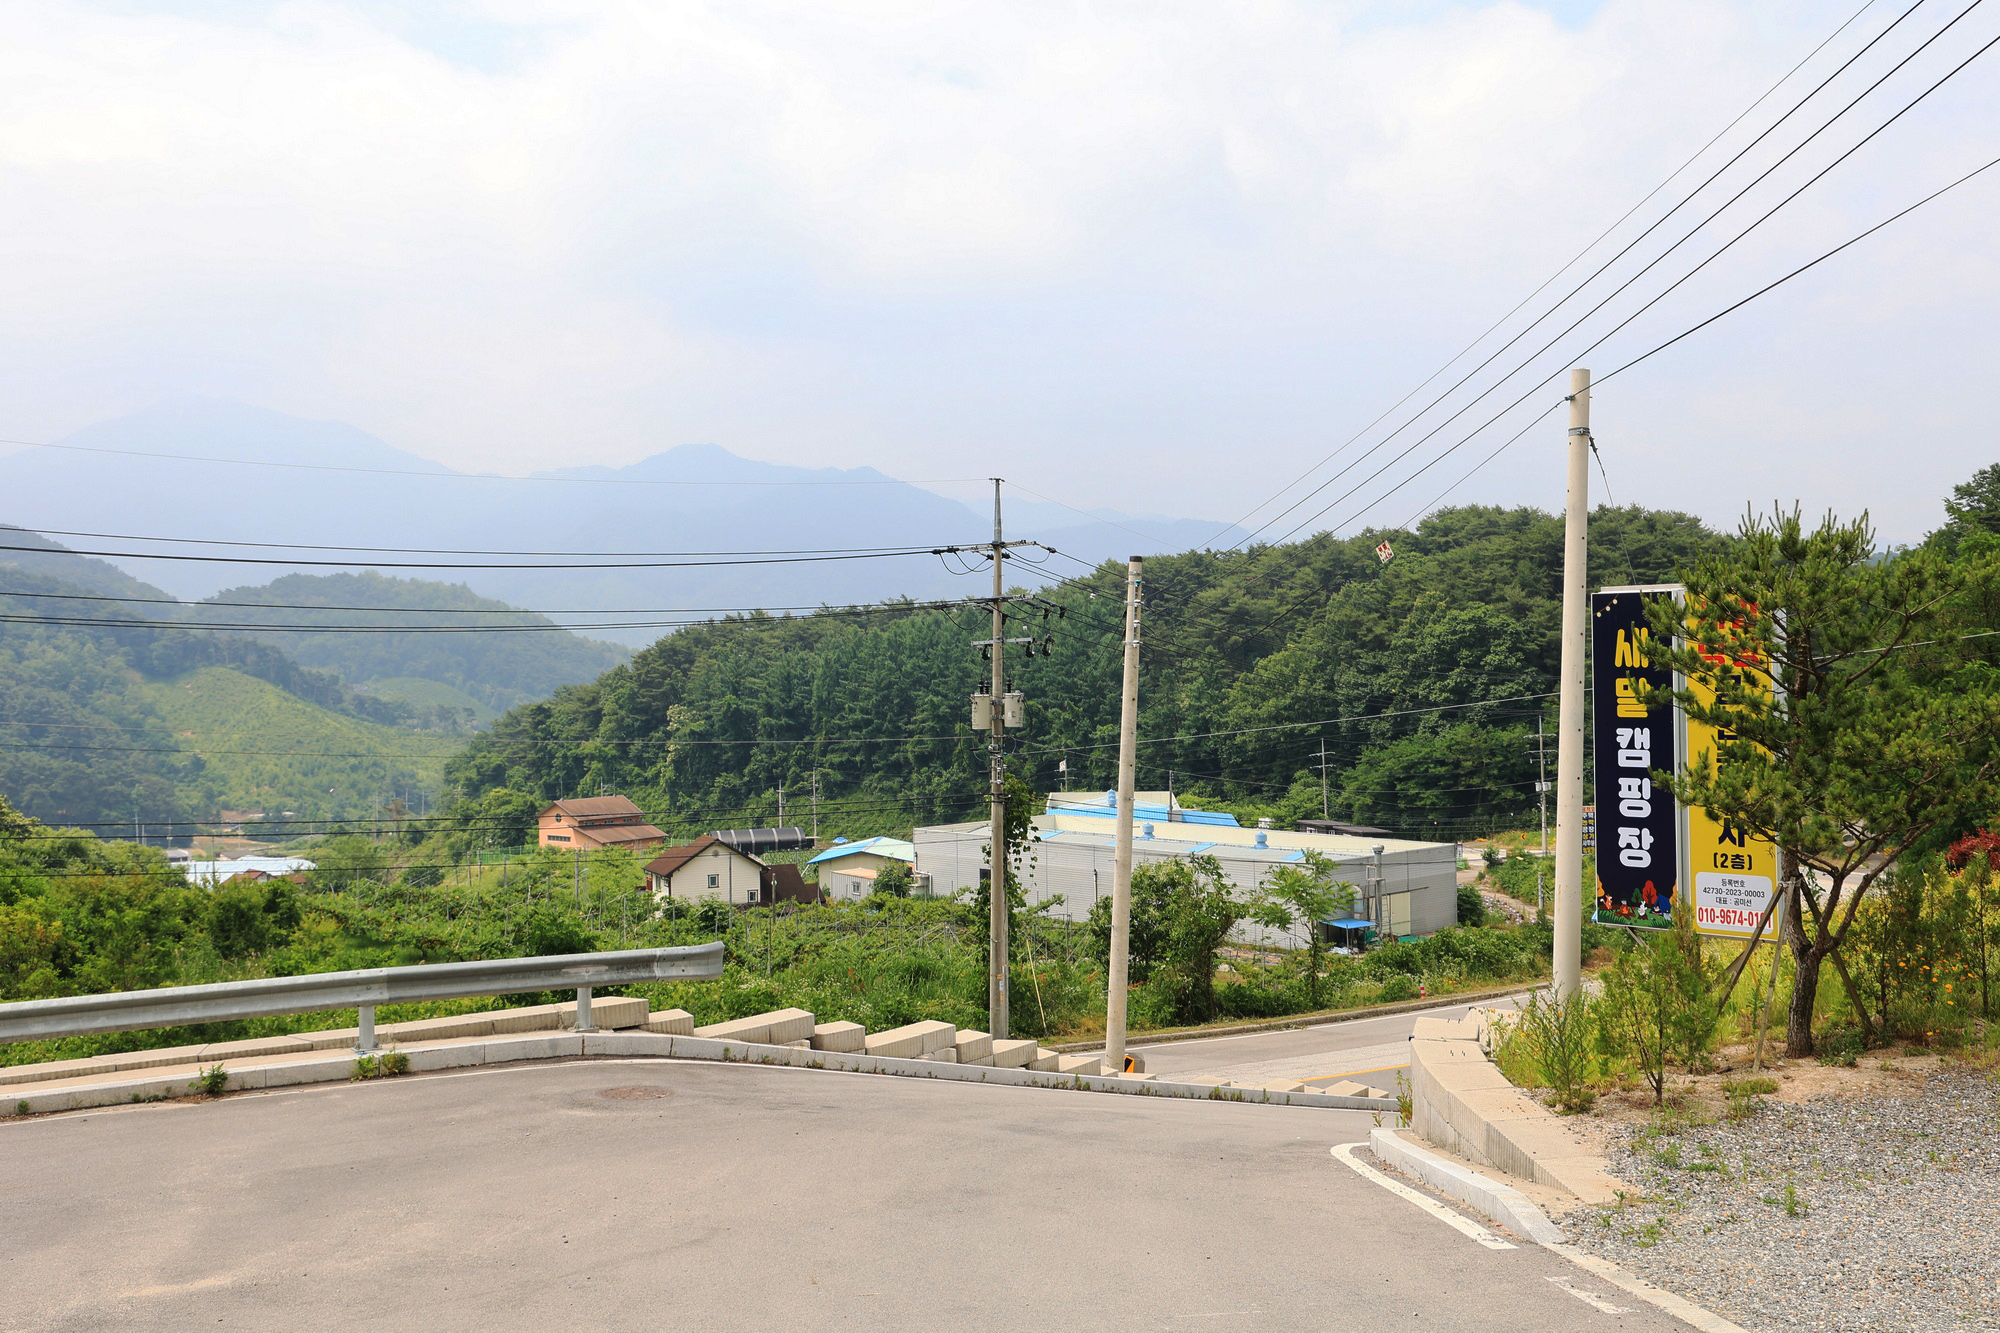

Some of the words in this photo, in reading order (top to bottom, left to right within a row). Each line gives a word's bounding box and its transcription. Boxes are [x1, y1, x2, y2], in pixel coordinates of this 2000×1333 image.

[1614, 627, 1651, 718] 새말
[1616, 727, 1654, 868] 캠핑장
[1713, 852, 1753, 871] (2층)
[1702, 886, 1766, 898] 42730-2023-00003
[1721, 878, 1746, 888] 등록번호
[1715, 896, 1728, 905] 대표
[1697, 906, 1772, 929] 010-9674-011
